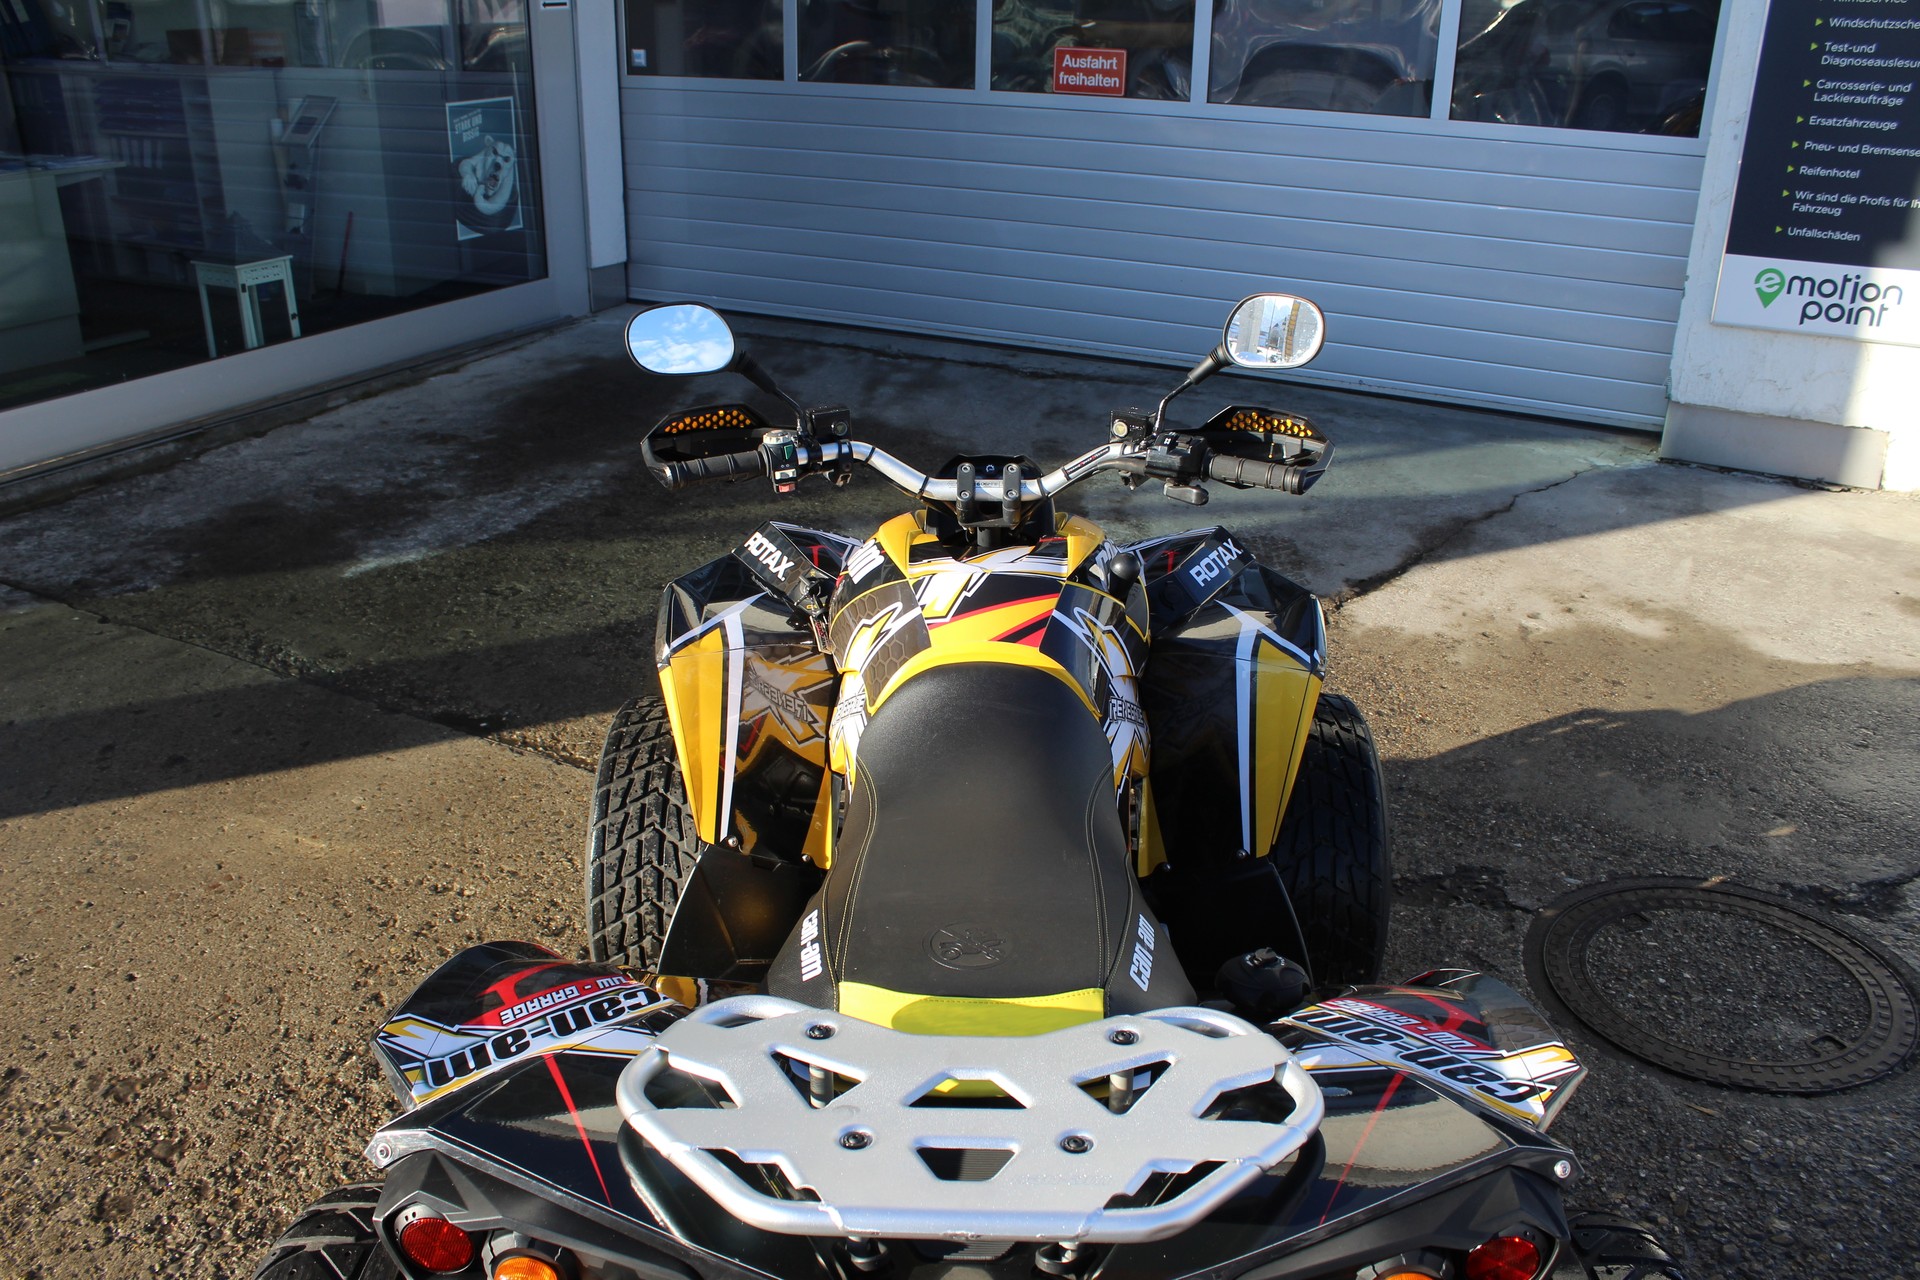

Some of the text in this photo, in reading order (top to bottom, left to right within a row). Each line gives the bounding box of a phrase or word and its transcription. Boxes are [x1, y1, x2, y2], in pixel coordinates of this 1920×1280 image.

[1824, 41, 1877, 54] Test-und
[1062, 54, 1118, 70] Ausfahrt
[1059, 71, 1120, 88] freihalten
[1816, 79, 1912, 93] Carrosserie- und
[1814, 92, 1904, 107] Lackieraufträge
[1809, 115, 1898, 131] Ersatzfahrzeuge
[1804, 141, 1835, 152] Pneu-
[1838, 144, 1859, 154] und
[1799, 165, 1861, 179] Reifenhotel
[1795, 190, 1814, 200] Wir
[1815, 192, 1839, 203] sind
[1840, 194, 1857, 204] die
[1859, 195, 1891, 207] Profis
[1893, 197, 1909, 208] für
[1792, 202, 1842, 217] Fahrzeug
[1787, 226, 1861, 242] Unfallschäden
[1799, 300, 1889, 328] point
[743, 531, 795, 582] ROTAX
[1189, 538, 1243, 588] ROTAX
[500, 984, 581, 1025] GARAGE
[424, 987, 664, 1088] can-am
[1289, 1010, 1550, 1104] can-am
